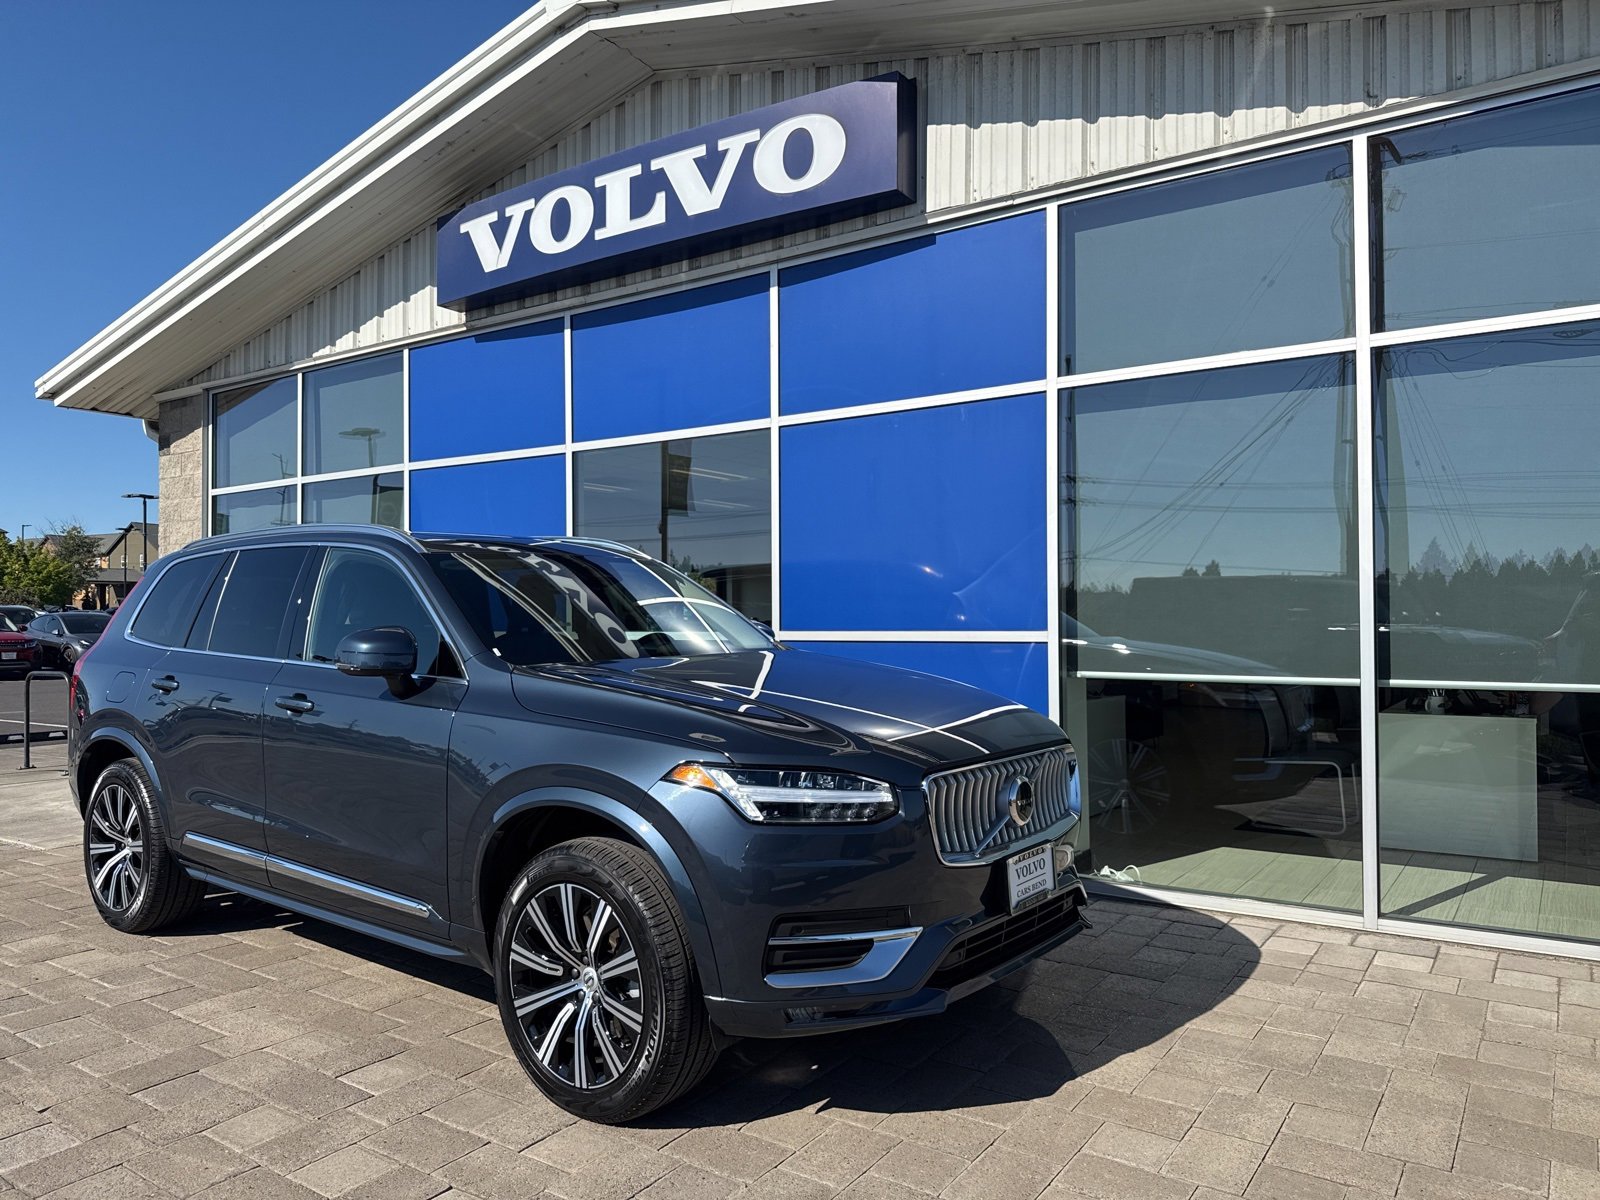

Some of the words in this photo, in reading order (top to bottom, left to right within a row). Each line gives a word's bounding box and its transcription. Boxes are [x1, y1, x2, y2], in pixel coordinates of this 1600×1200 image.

[460, 113, 847, 273] VOLVO
[1015, 858, 1046, 880] VOLVO
[1017, 885, 1031, 898] CARS
[1032, 879, 1047, 891] BEND
